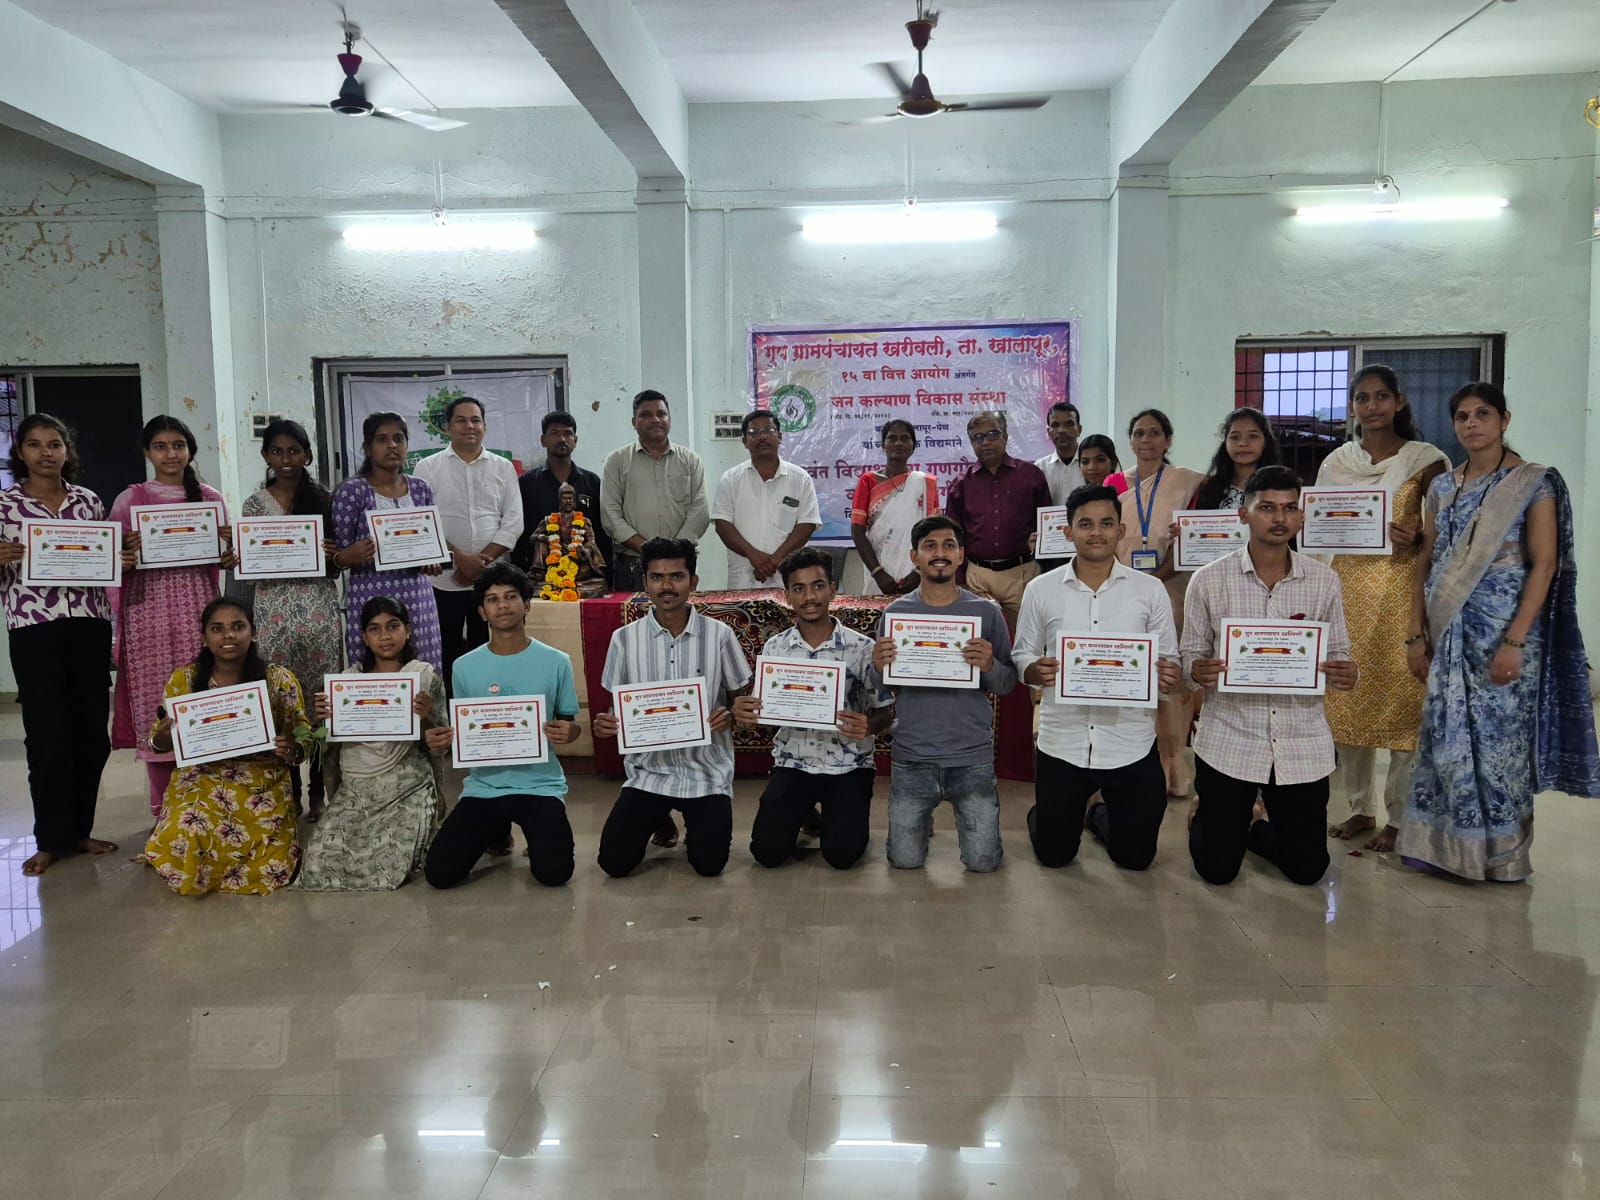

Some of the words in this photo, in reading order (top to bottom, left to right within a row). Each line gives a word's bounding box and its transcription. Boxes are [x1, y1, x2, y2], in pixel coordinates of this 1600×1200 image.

[792, 339, 878, 361] ग्रामपंचायत
[882, 336, 952, 358] खरीवली,
[958, 338, 982, 354] ता.
[842, 371, 858, 383] १५
[862, 370, 876, 381] वा
[881, 366, 905, 381] वित्त
[911, 364, 950, 379] आयोग
[831, 396, 853, 408] जन
[859, 394, 910, 408] कल्याण
[916, 388, 963, 405] विकास
[968, 387, 1006, 405] संस्था
[926, 435, 962, 449] विद्यमाने
